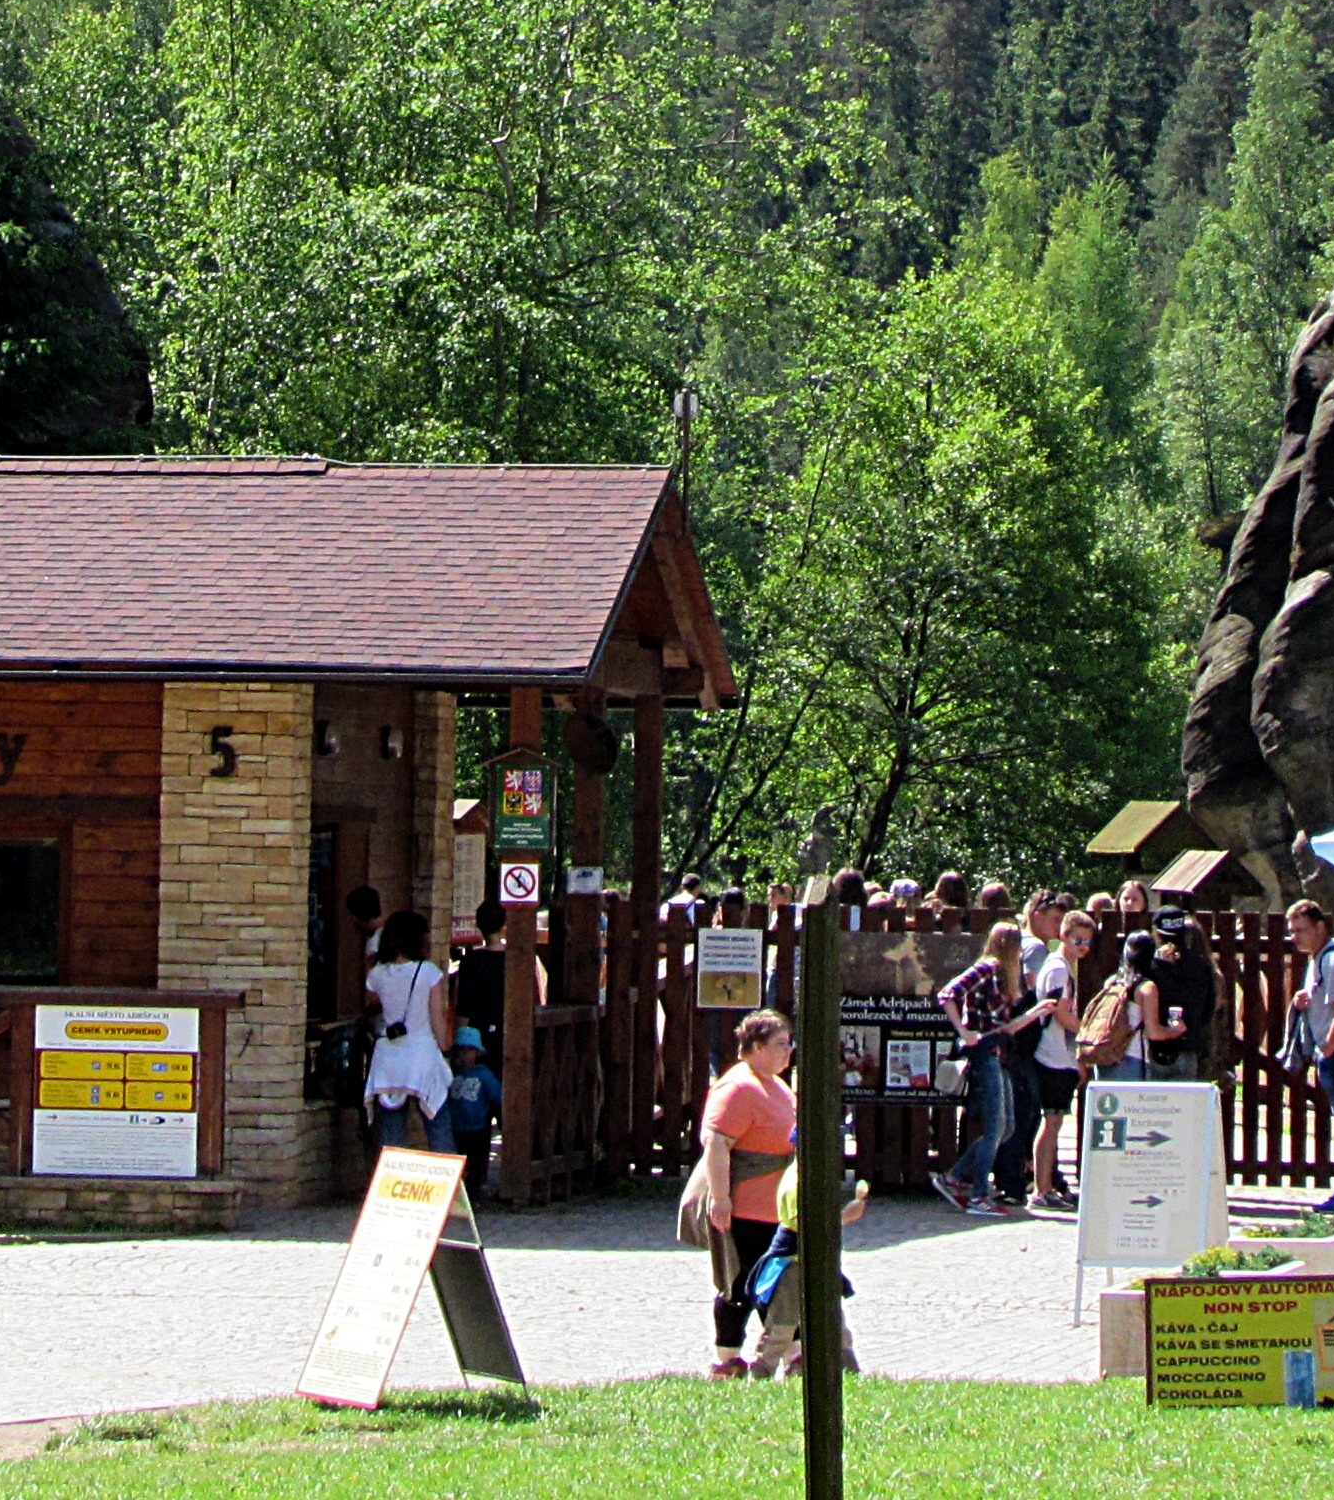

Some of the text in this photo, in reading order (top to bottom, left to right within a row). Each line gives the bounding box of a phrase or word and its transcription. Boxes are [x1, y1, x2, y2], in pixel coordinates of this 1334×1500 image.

[210, 725, 236, 778] 5
[879, 996, 932, 1011] Adršpach
[71, 1025, 162, 1037] CENÍK VSTUPNÉHO
[391, 1179, 435, 1203] CENÍK
[1203, 1301, 1298, 1314] NON STOP
[1156, 1322, 1196, 1334] KÁVA
[1208, 1322, 1238, 1333] ČAJ
[1156, 1338, 1196, 1350] KÁVA
[1201, 1339, 1220, 1350] SE
[1225, 1337, 1313, 1349] SMETANOU
[1156, 1355, 1261, 1367] CAPPUCCINO
[1156, 1371, 1267, 1383] MOCCACCINO
[1157, 1387, 1244, 1400] ČOKOLÁDA
